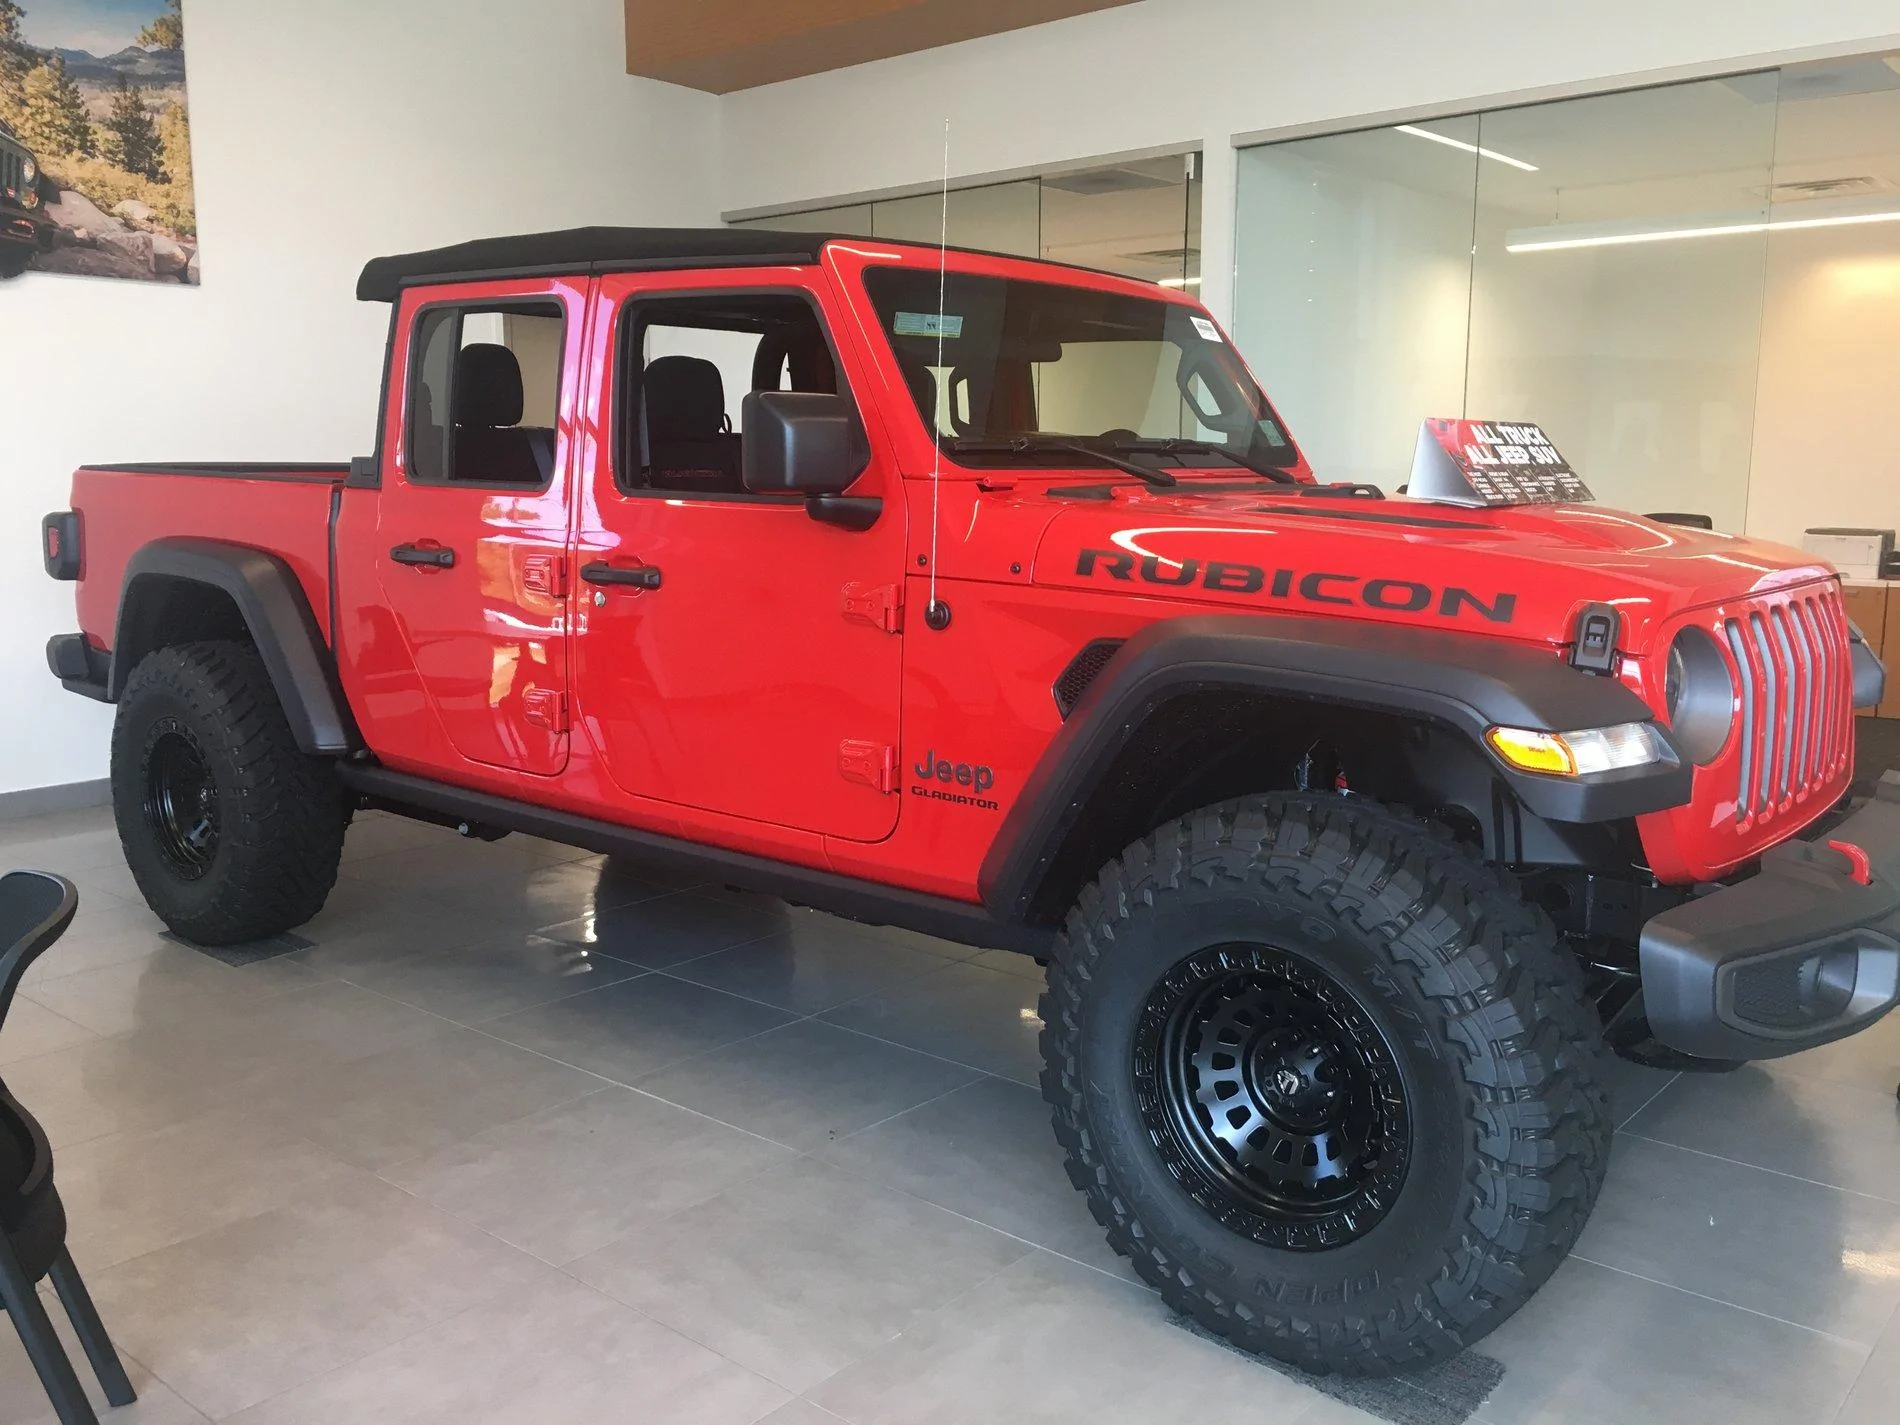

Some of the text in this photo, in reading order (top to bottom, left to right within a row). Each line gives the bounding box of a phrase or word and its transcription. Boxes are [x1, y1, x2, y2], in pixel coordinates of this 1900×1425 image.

[1470, 424, 1550, 445] ALL TRUCK
[1464, 444, 1500, 465] ALL
[1528, 446, 1562, 465] SUV
[1074, 548, 1517, 623] RUBICON
[914, 749, 994, 794] Jeep
[911, 785, 999, 811] GLADIATOR
